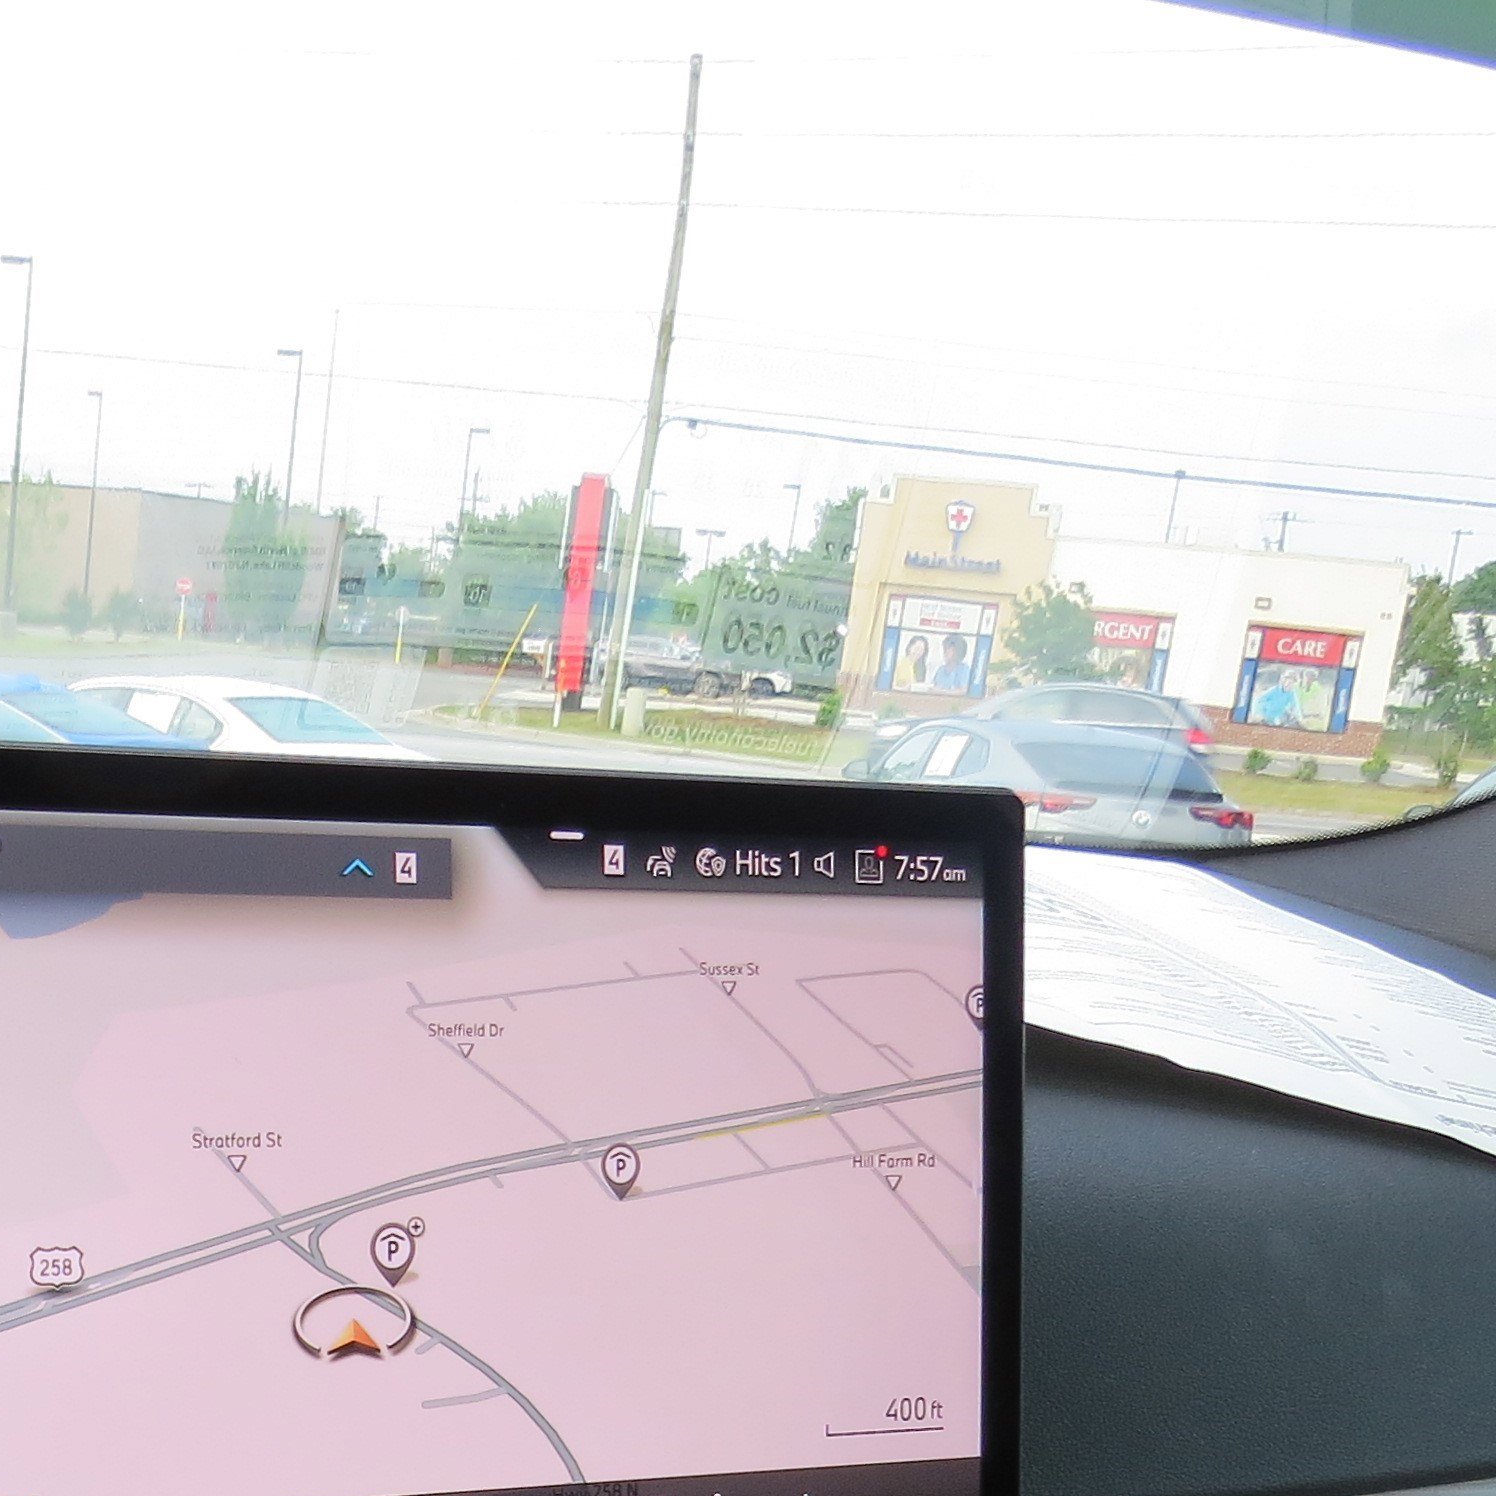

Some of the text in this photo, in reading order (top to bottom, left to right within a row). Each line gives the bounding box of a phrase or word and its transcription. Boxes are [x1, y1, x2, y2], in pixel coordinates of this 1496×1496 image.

[1093, 620, 1154, 641] RGENT
[1277, 638, 1327, 659] CARE
[398, 855, 415, 881] 4
[606, 847, 622, 873] 4
[735, 849, 801, 877] Hits 1
[699, 960, 760, 977] Sussex St
[428, 1022, 505, 1037] Sheffield Dr
[191, 1131, 282, 1149] Stratford St
[852, 1152, 936, 1168] Hill Farm Rd
[39, 1258, 73, 1277] 258
